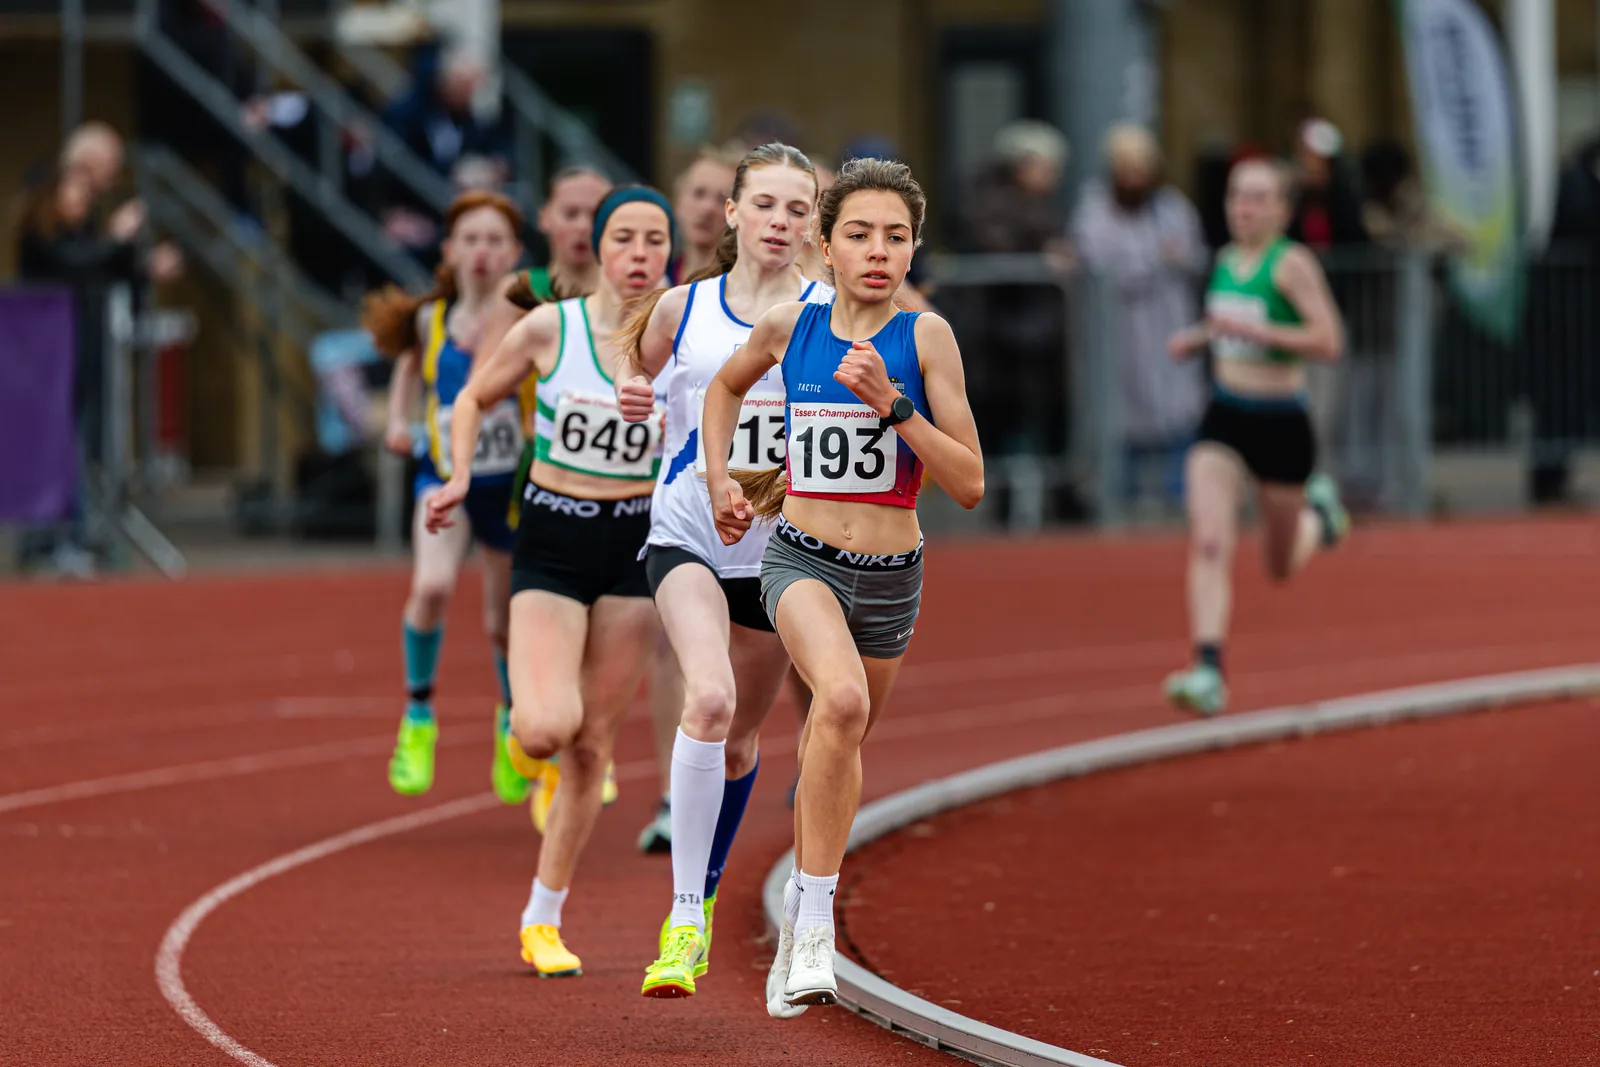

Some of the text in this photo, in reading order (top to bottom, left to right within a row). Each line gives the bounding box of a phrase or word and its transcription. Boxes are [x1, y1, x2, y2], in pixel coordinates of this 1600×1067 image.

[797, 382, 822, 393] TACTIC
[743, 398, 787, 408] ampions
[794, 408, 817, 417] Essex
[561, 412, 650, 463] 649
[728, 415, 786, 464] 13
[796, 426, 885, 480] 193
[532, 489, 600, 518] PRO
[835, 550, 910, 567] NIKE
